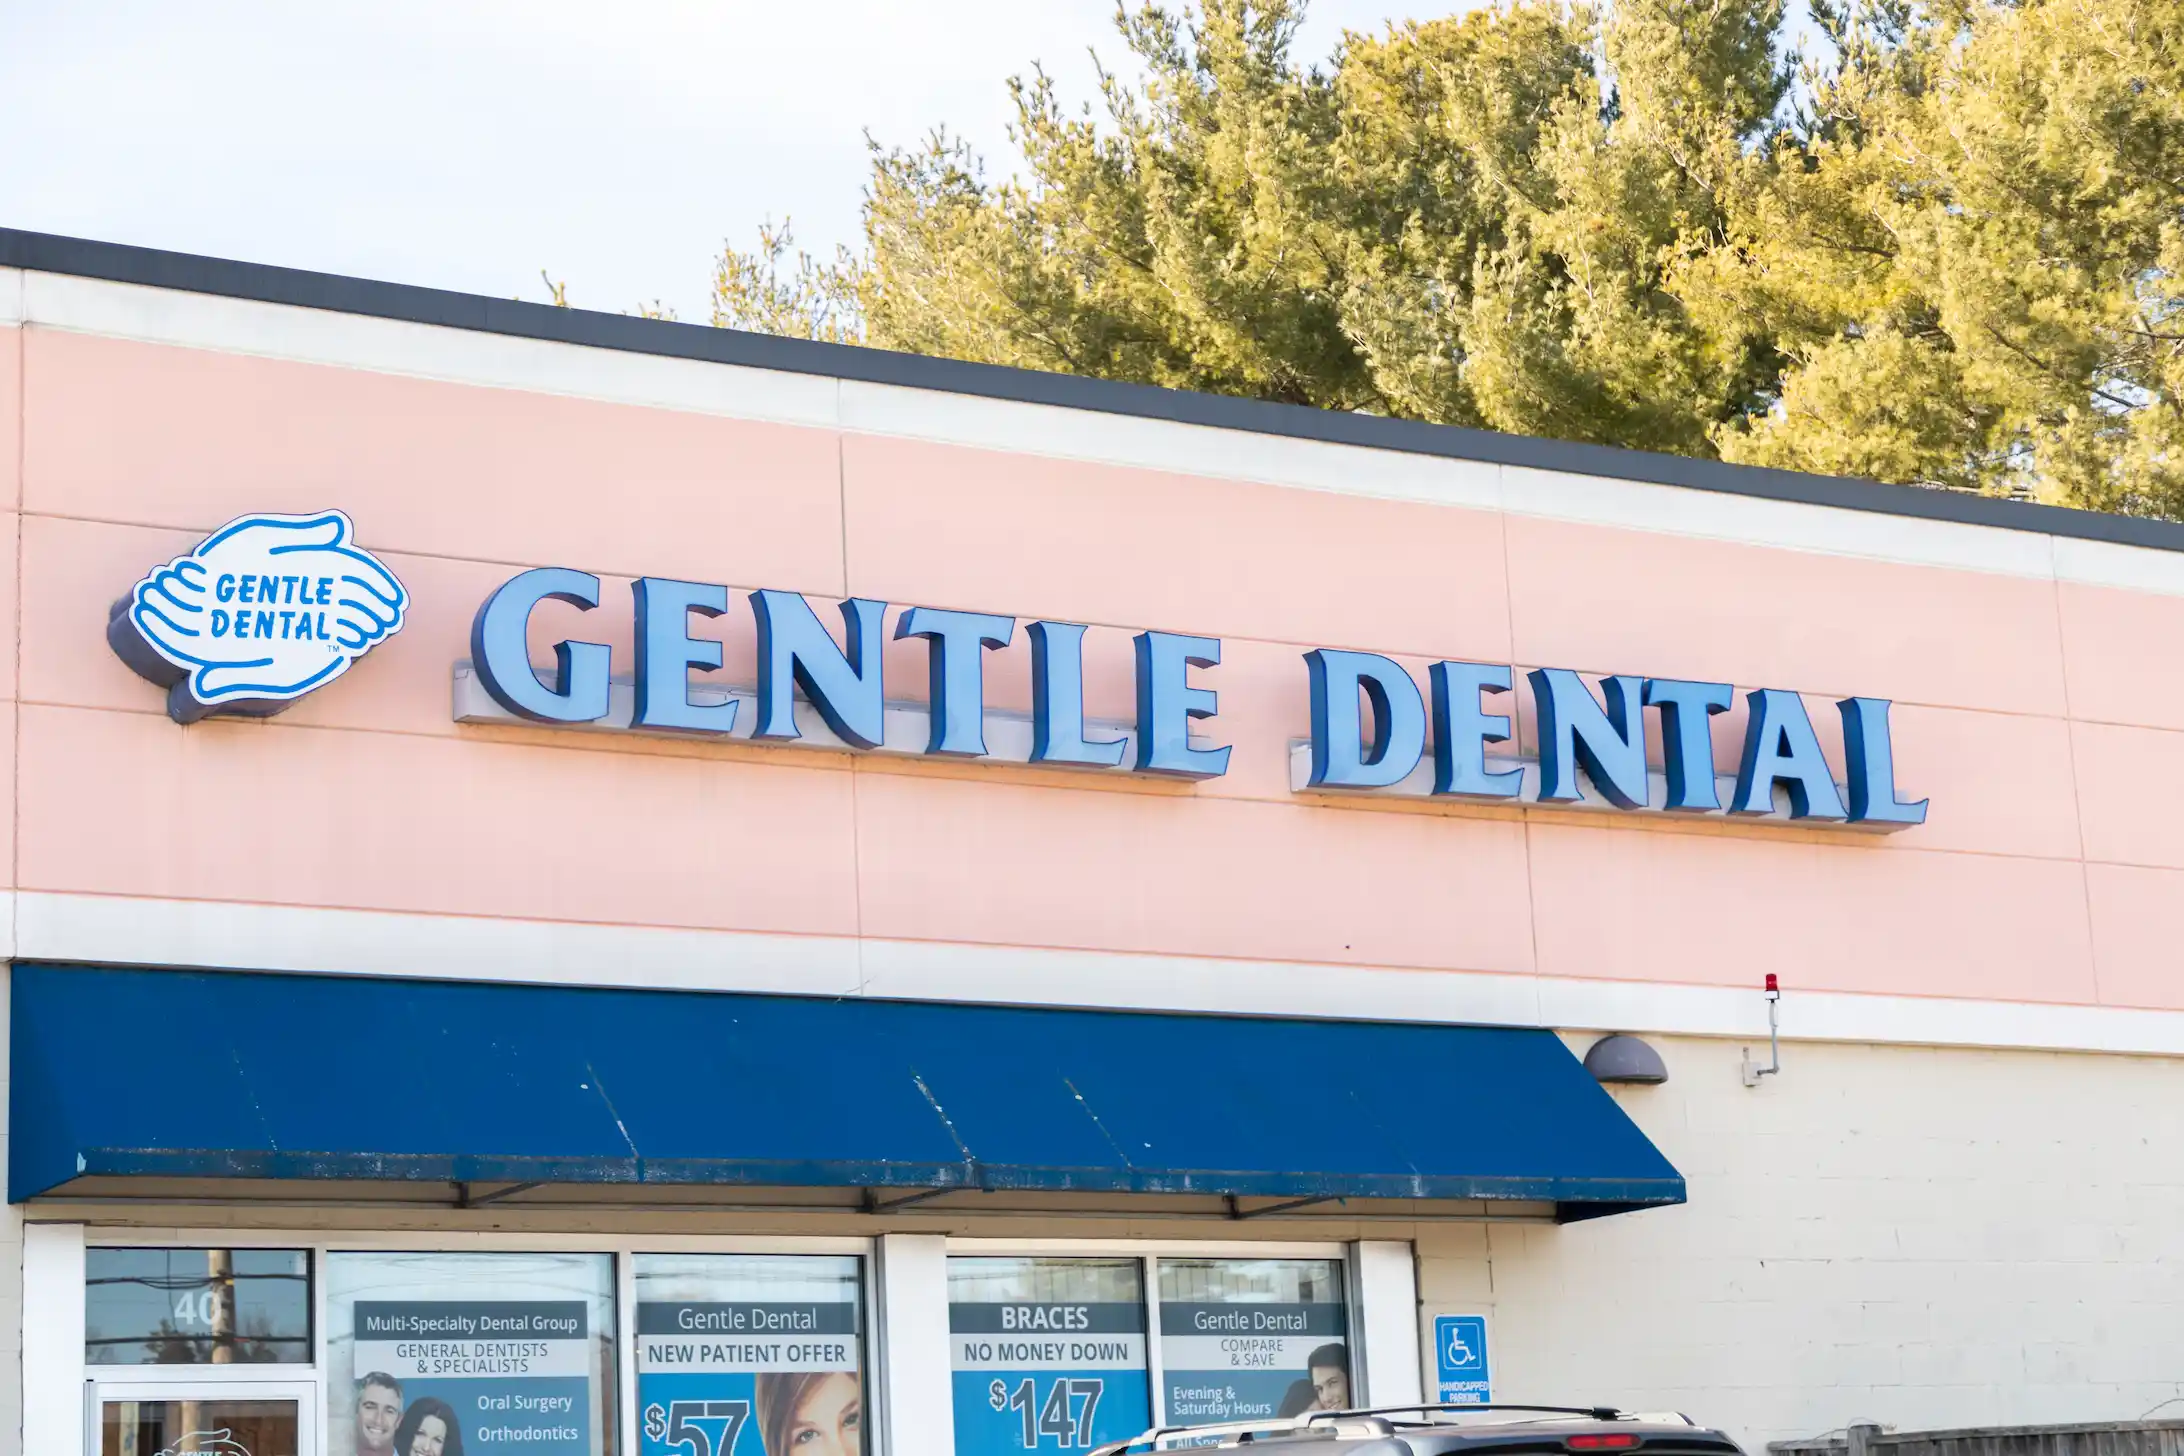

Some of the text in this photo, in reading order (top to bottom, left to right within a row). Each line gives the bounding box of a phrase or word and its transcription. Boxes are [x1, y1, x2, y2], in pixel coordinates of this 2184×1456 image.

[216, 573, 334, 605] GENTLE
[210, 608, 331, 641] DENTAL
[471, 567, 1930, 827] GENTLE DENTAL
[174, 1291, 222, 1326] 40
[1001, 1306, 1090, 1330] BRACES
[366, 1315, 579, 1335] Multi-Specialty Dental Group
[678, 1307, 817, 1330] Gentle Dental
[1194, 1310, 1308, 1330] Gentle Dental
[396, 1343, 548, 1358] GENERAL DENTISTS
[648, 1343, 846, 1363] NEW PATIENT OFFER
[964, 1343, 1128, 1361] NO MONEY DOWN
[1221, 1339, 1284, 1353] COMPARE
[416, 1358, 529, 1374] & SPECIALISTS
[1231, 1353, 1276, 1367] & SAVE
[1173, 1386, 1236, 1403] Evening &
[1439, 1381, 1489, 1392] HANDICAPPED
[477, 1395, 573, 1412] Oral Surgery
[1174, 1402, 1272, 1418] Saturday Hours
[989, 1378, 1104, 1449] $147
[478, 1426, 579, 1442] Orthodontics
